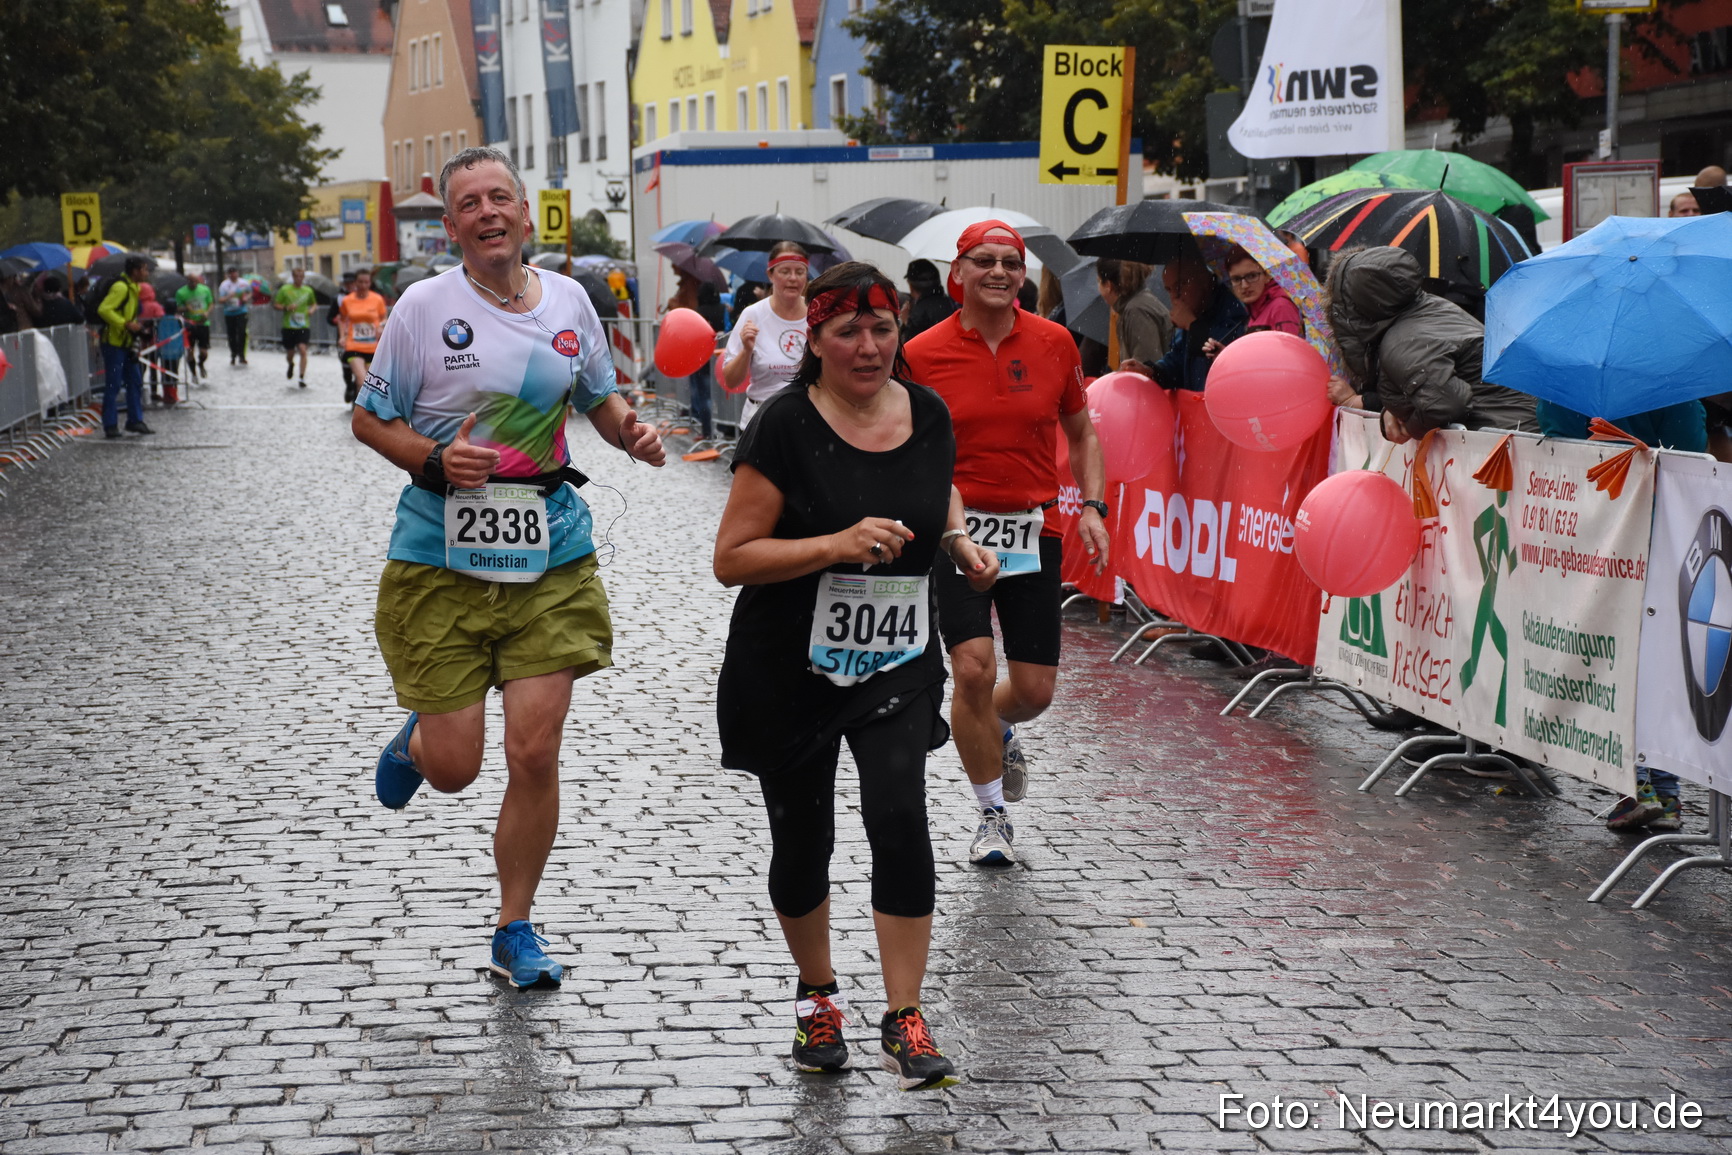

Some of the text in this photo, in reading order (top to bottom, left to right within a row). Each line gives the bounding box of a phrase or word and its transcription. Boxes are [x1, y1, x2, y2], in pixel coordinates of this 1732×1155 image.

[475, 13, 500, 73] K&L
[1055, 52, 1123, 77] Block
[1063, 88, 1109, 155] C
[72, 210, 92, 236] D
[547, 206, 563, 231] D
[444, 319, 470, 330] BMW
[443, 353, 480, 365] PARTL
[445, 361, 481, 372] Neumarkt
[493, 487, 538, 501] BOCK
[457, 507, 542, 545] 2338
[966, 516, 1033, 550] 2251
[469, 552, 528, 569] Christian
[873, 581, 921, 594] BOCK
[826, 601, 918, 646] 3044
[1522, 609, 1616, 671] Gebäudereinigung
[1524, 657, 1617, 713] Hausmeisterdienst
